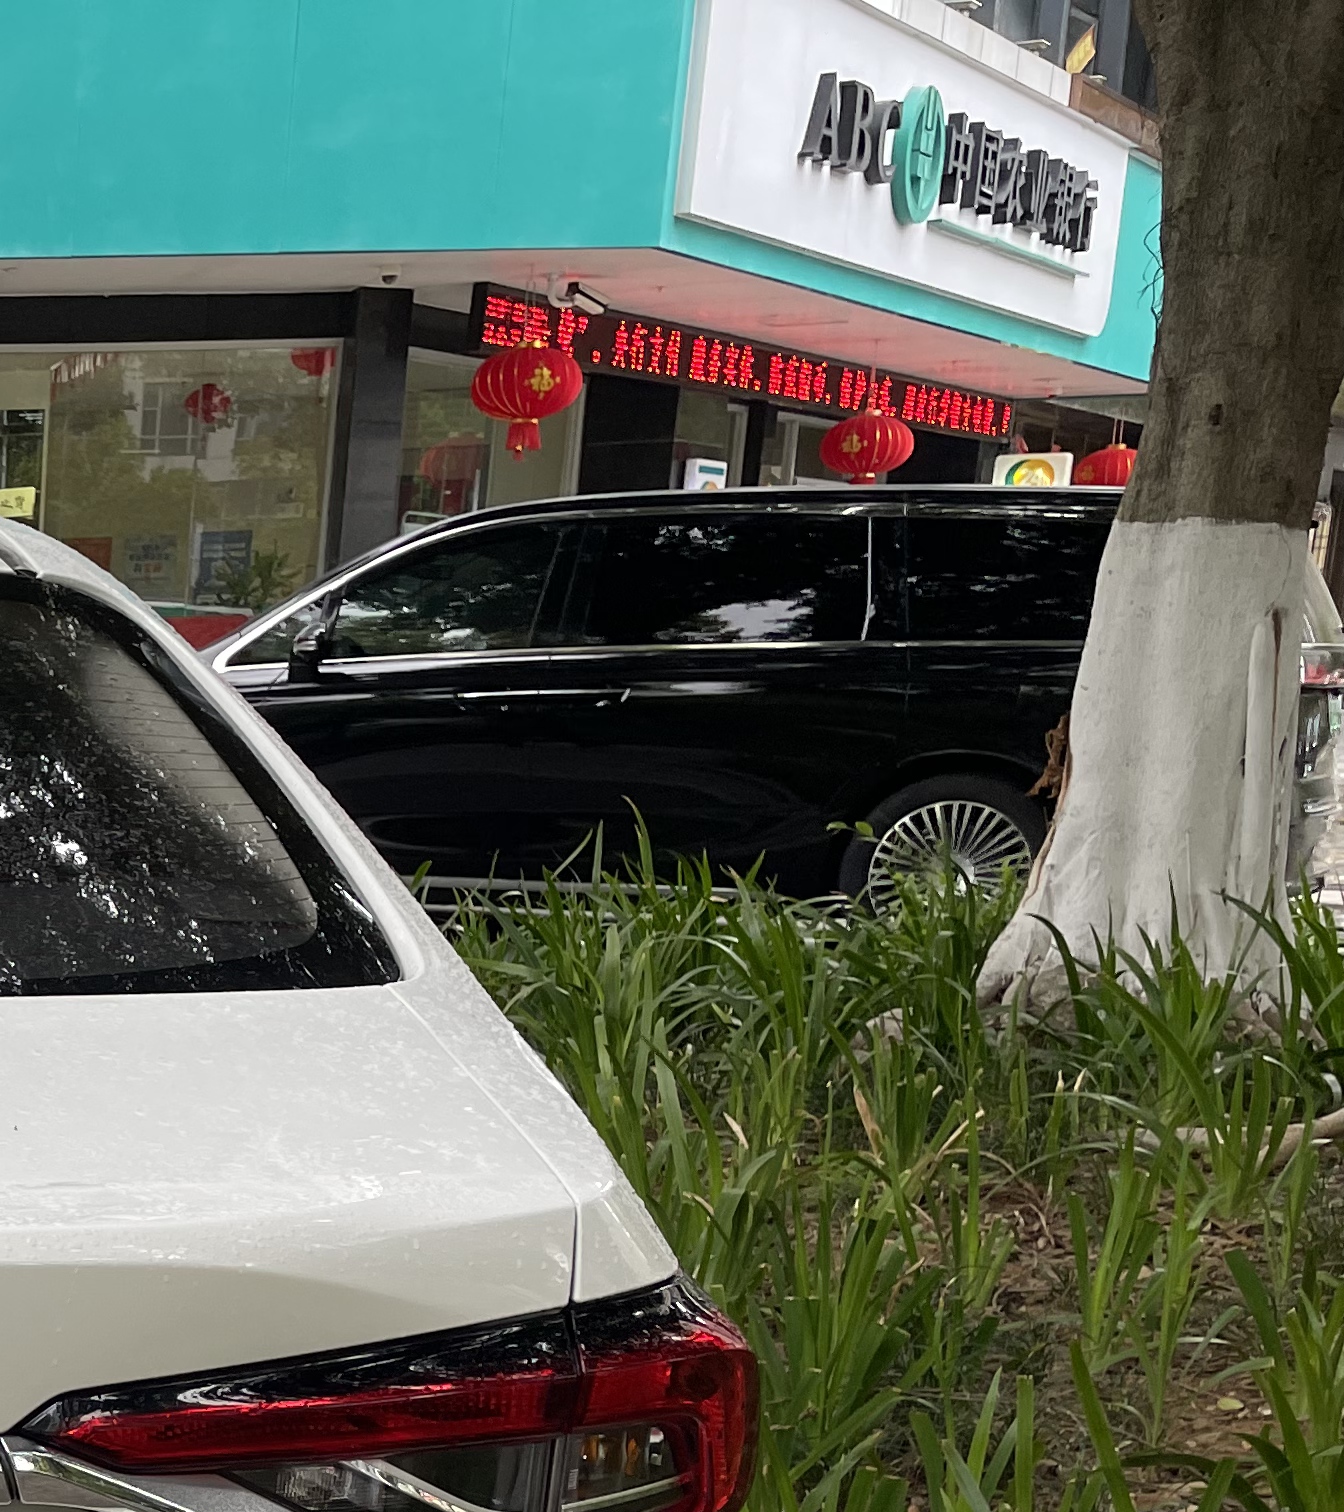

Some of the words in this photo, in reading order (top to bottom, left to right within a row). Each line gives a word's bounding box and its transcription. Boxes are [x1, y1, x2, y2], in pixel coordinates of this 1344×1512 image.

[798, 71, 904, 185] ABC
[939, 111, 1099, 253] 中国农业银行
